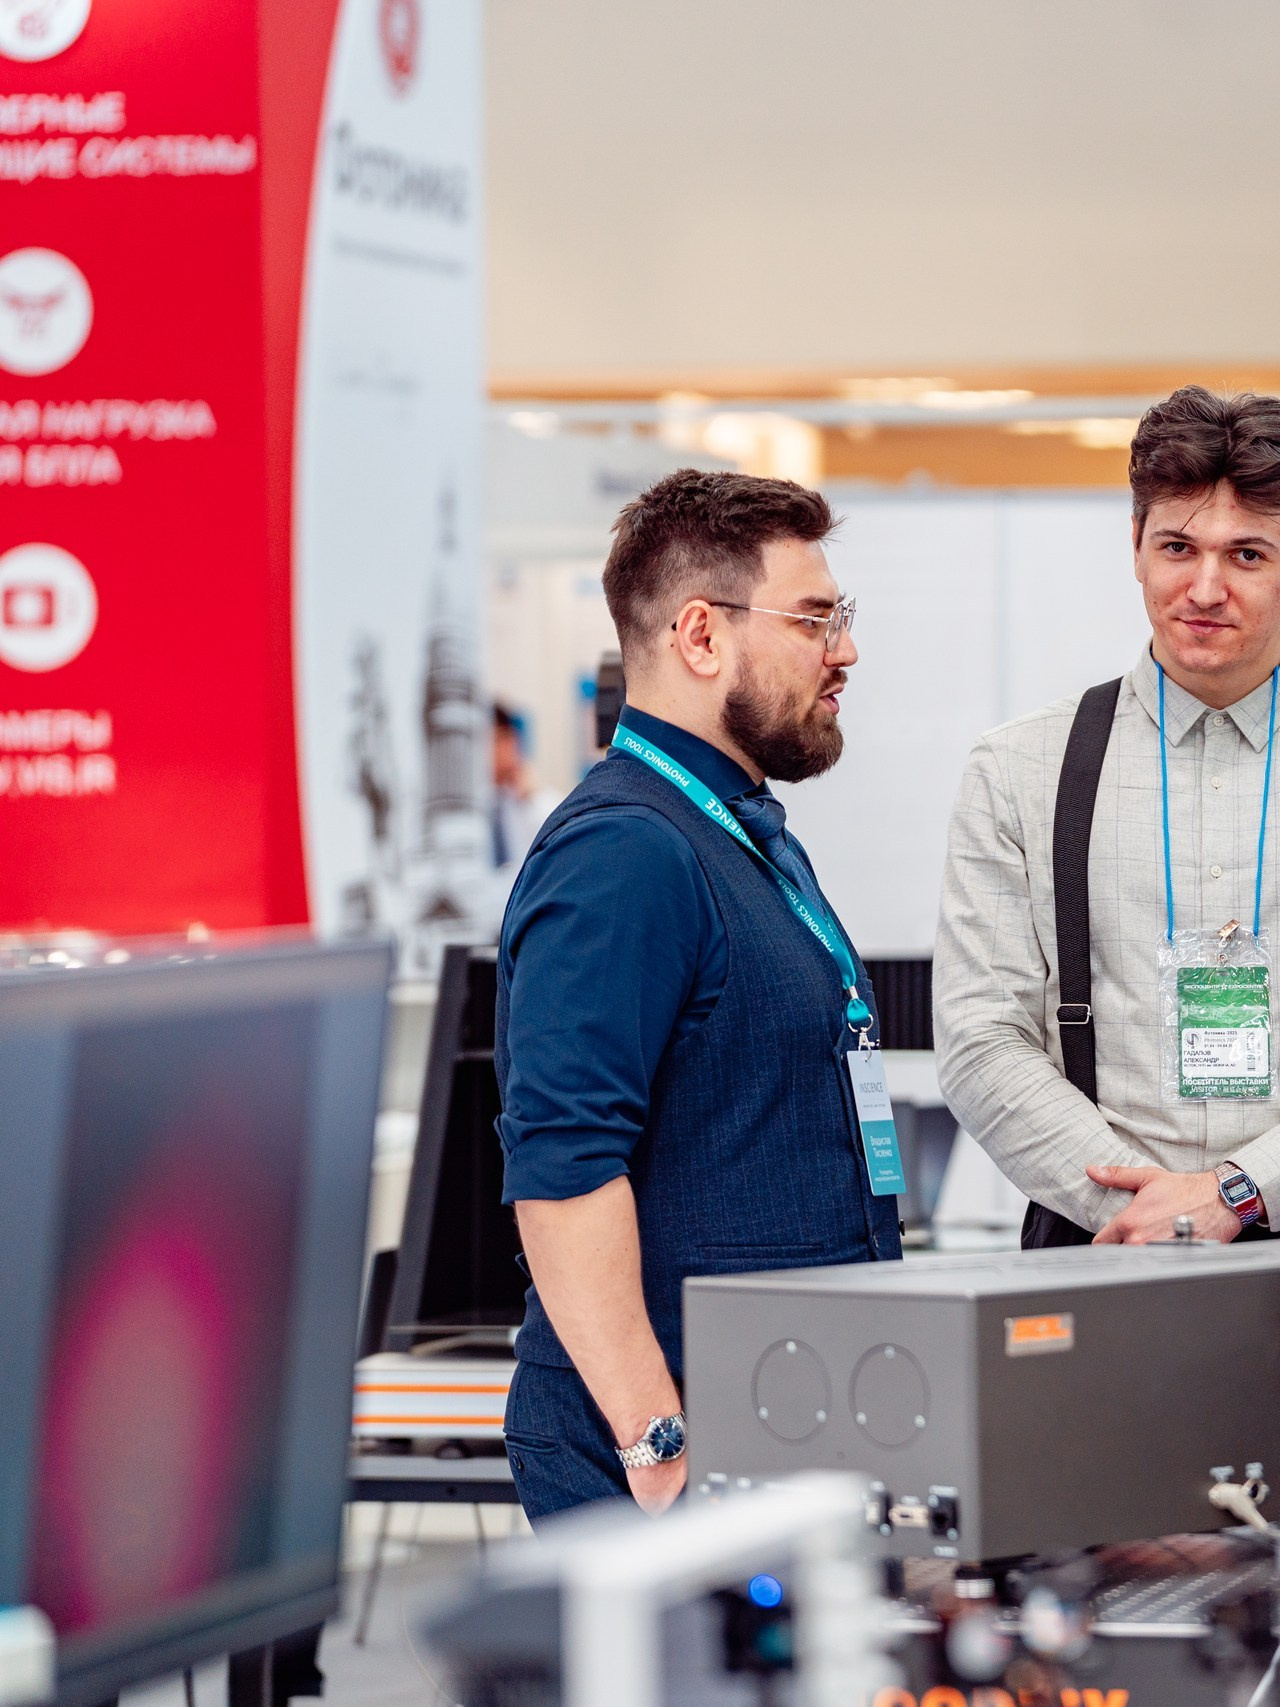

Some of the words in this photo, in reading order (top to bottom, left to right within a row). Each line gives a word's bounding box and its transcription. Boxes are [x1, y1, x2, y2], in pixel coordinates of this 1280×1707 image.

[79, 134, 257, 178] СИСТЕМЫ
[623, 737, 645, 754] TOOLS
[643, 749, 690, 787] PHOTONICS
[777, 879, 800, 906] TOOLS
[1183, 1078, 1228, 1086] ПОСЕТИТЕЛЬ
[1192, 1085, 1218, 1093] VISITOR
